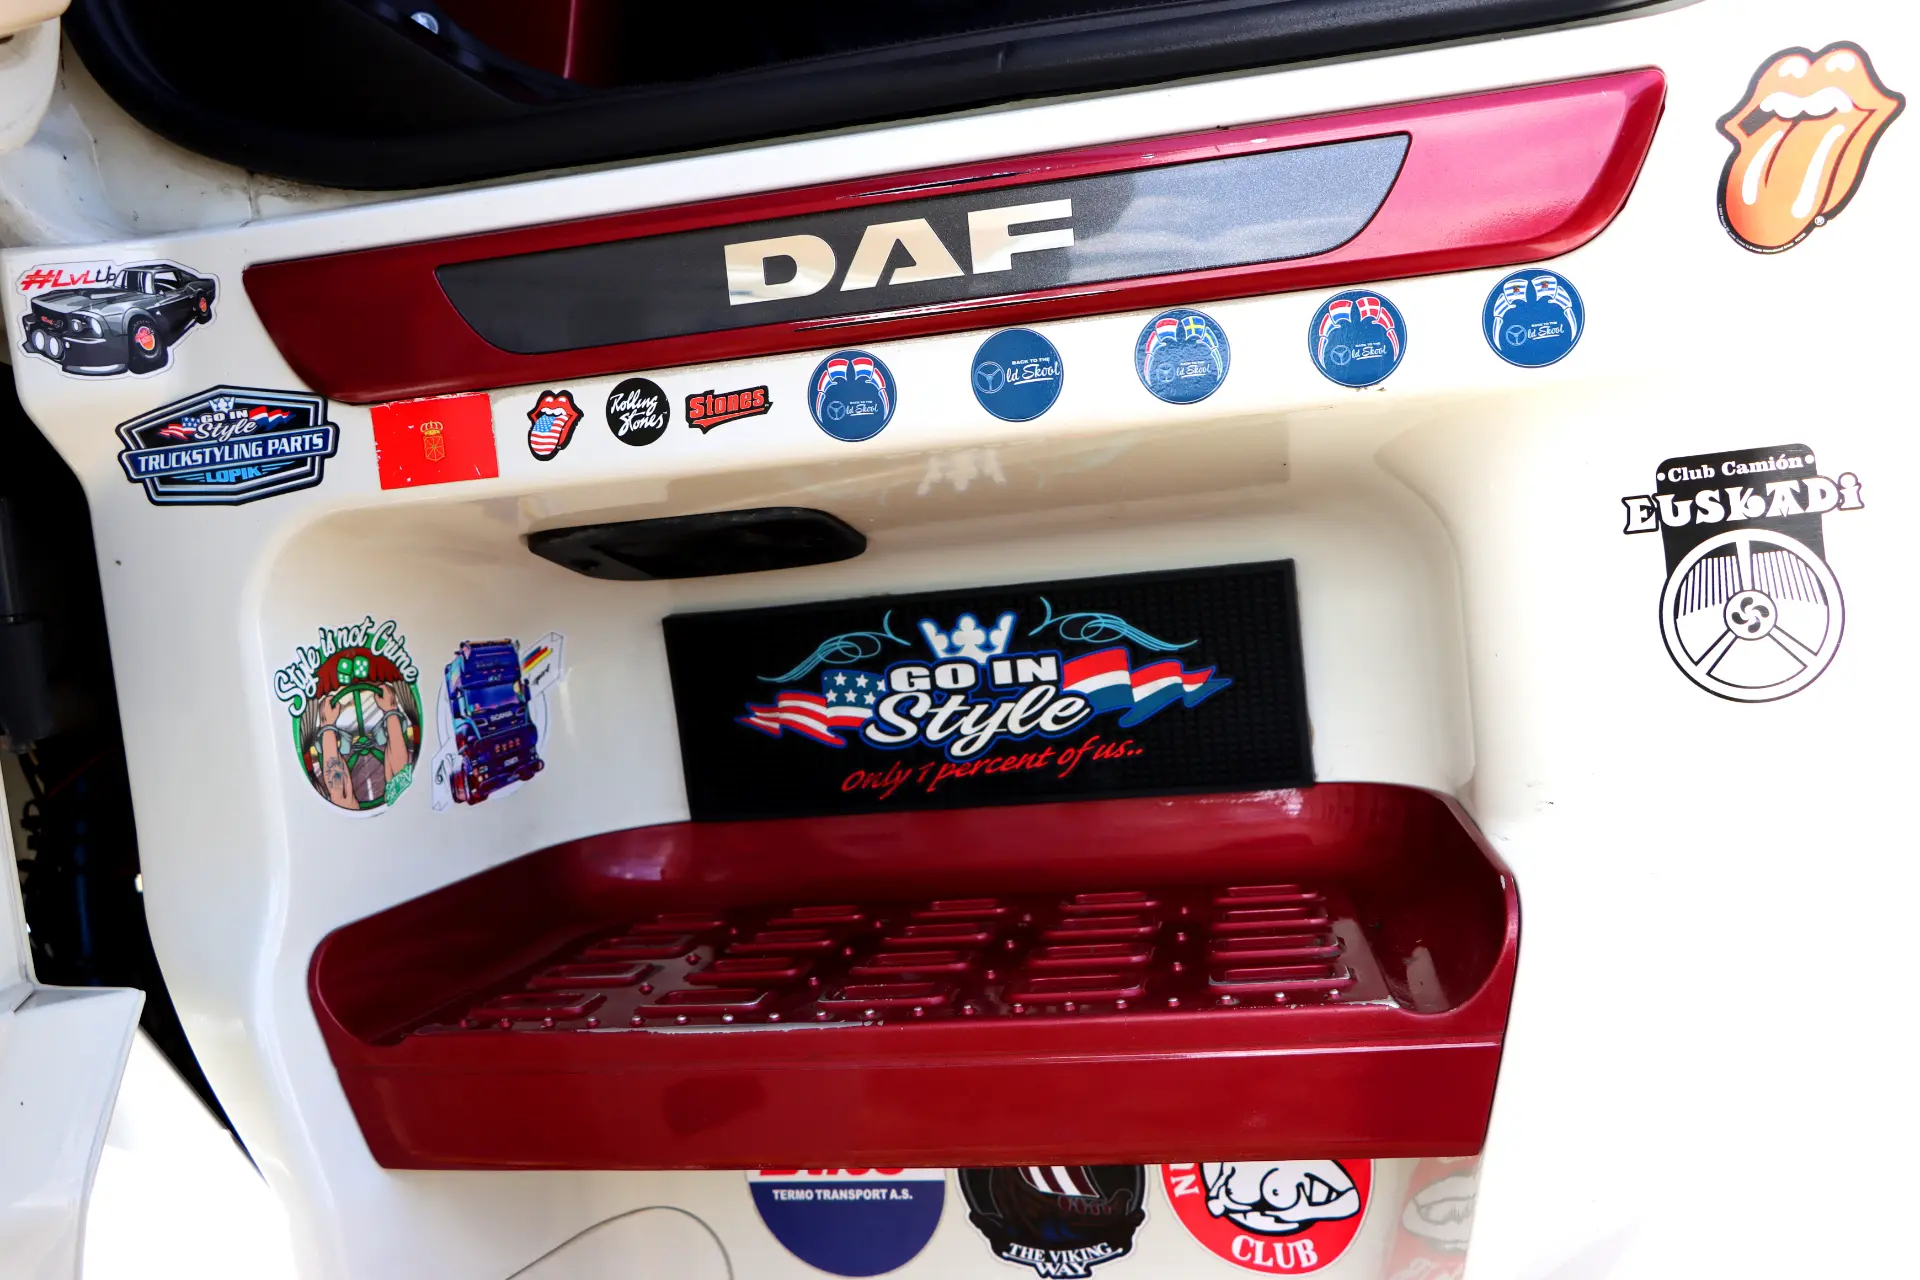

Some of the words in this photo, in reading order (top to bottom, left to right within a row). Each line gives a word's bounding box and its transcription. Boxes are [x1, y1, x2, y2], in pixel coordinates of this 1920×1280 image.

[723, 198, 1075, 306] DAF
[1538, 323, 1565, 337] Skool
[1361, 344, 1388, 357] Skool
[1021, 361, 1061, 380] Skool
[610, 389, 659, 415] Rolling
[689, 388, 765, 419] Stones
[855, 403, 879, 414] Skool
[200, 411, 226, 423] GO
[229, 408, 249, 420] IN
[617, 409, 664, 437] Stones
[194, 419, 258, 442] Style
[138, 438, 264, 473] TRUCKSTYLING
[267, 432, 324, 456] PARTS
[205, 465, 262, 484] LOPIK
[1667, 464, 1716, 483] Club
[1721, 453, 1804, 477] Camión
[274, 646, 321, 717] Style
[318, 626, 337, 658] is
[337, 615, 375, 649] not
[370, 620, 419, 684] Crime
[889, 660, 976, 694] GO
[991, 654, 1060, 683] IN
[864, 685, 1091, 758] Style
[917, 761, 935, 784] 1
[926, 746, 1057, 793] percent
[1057, 735, 1101, 778] of
[772, 1188, 814, 1201] TERMO
[814, 1188, 888, 1200] TRANSPORT
[889, 1187, 914, 1200] A.S.
[1009, 1242, 1046, 1262] THE
[1048, 1242, 1113, 1263] VIKING
[1231, 1234, 1319, 1270] CLUB
[1035, 1261, 1090, 1277] WAY
